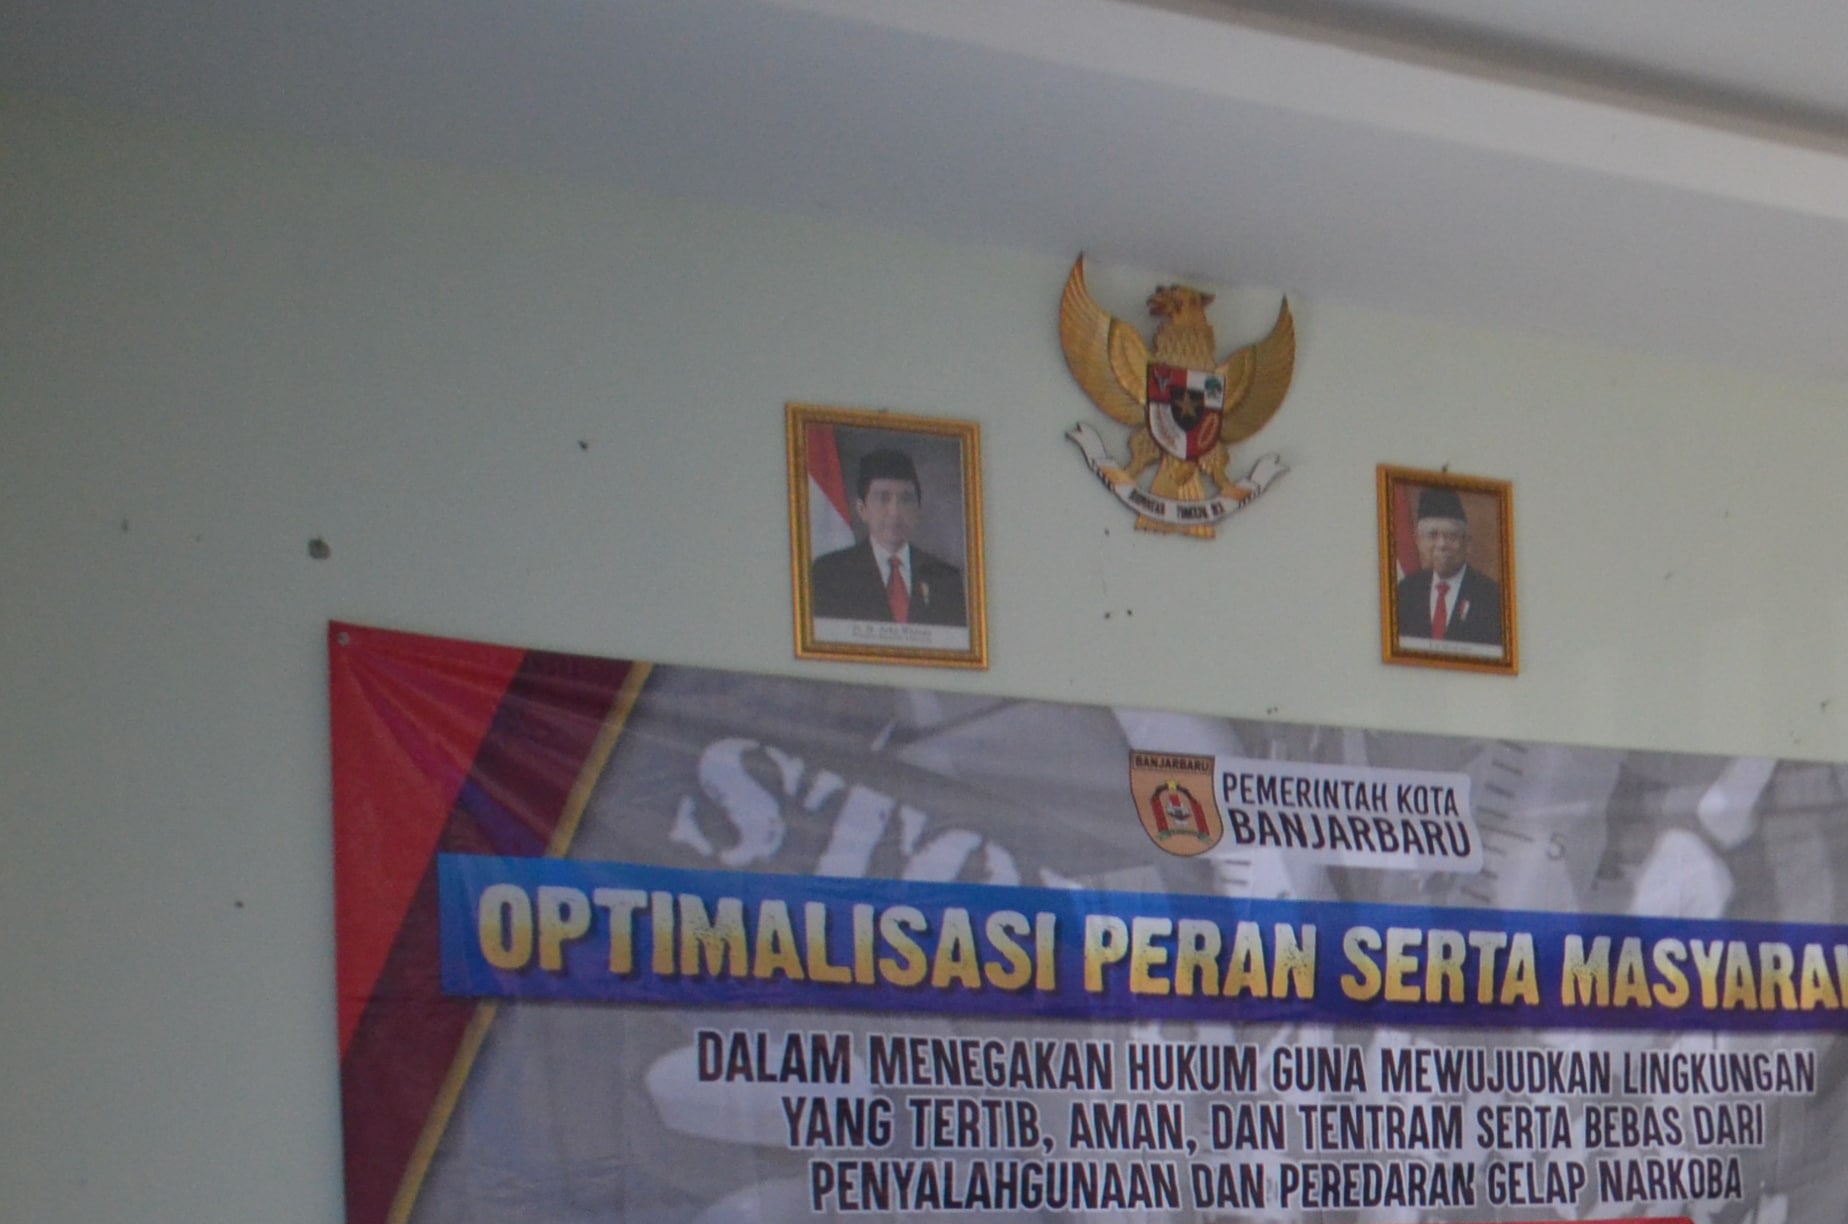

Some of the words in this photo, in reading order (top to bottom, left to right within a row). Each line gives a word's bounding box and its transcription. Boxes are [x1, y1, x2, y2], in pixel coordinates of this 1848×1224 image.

[1135, 756, 1210, 772] BANJARBARU
[1223, 771, 1388, 813] PEMERINTAH
[1397, 784, 1460, 817] KOTA
[1228, 808, 1472, 858] BANJARBARU
[479, 883, 1057, 992] OPTIMALISASI
[1084, 913, 1317, 1000] PERAN
[1340, 926, 1540, 1006] SERTA
[698, 1031, 850, 1085] DALAM
[869, 1035, 1112, 1091] MENEGAKAN
[1129, 1043, 1258, 1092] HUKUM
[1273, 1046, 1366, 1093] GUNA
[1381, 1047, 1611, 1095] MEWUJUDKAN
[1623, 1051, 1816, 1096] LINGKUNGAN
[782, 1096, 891, 1148] YANG
[909, 1098, 1055, 1154] TERTIB,
[1069, 1102, 1198, 1155] AMAN,
[1212, 1104, 1285, 1151] DAN
[1299, 1104, 1463, 1150] TENTRAM
[1477, 1104, 1571, 1150] SERTA
[1584, 1103, 1682, 1149] BEBAS
[1695, 1103, 1764, 1145] DARI
[811, 1160, 1180, 1211] PENYALAHGUNAAN
[1192, 1163, 1265, 1209] DAN
[1279, 1162, 1476, 1208] PEREDARAN
[1487, 1162, 1585, 1205] GELAP
[1600, 1157, 1742, 1202] NARKOBA
